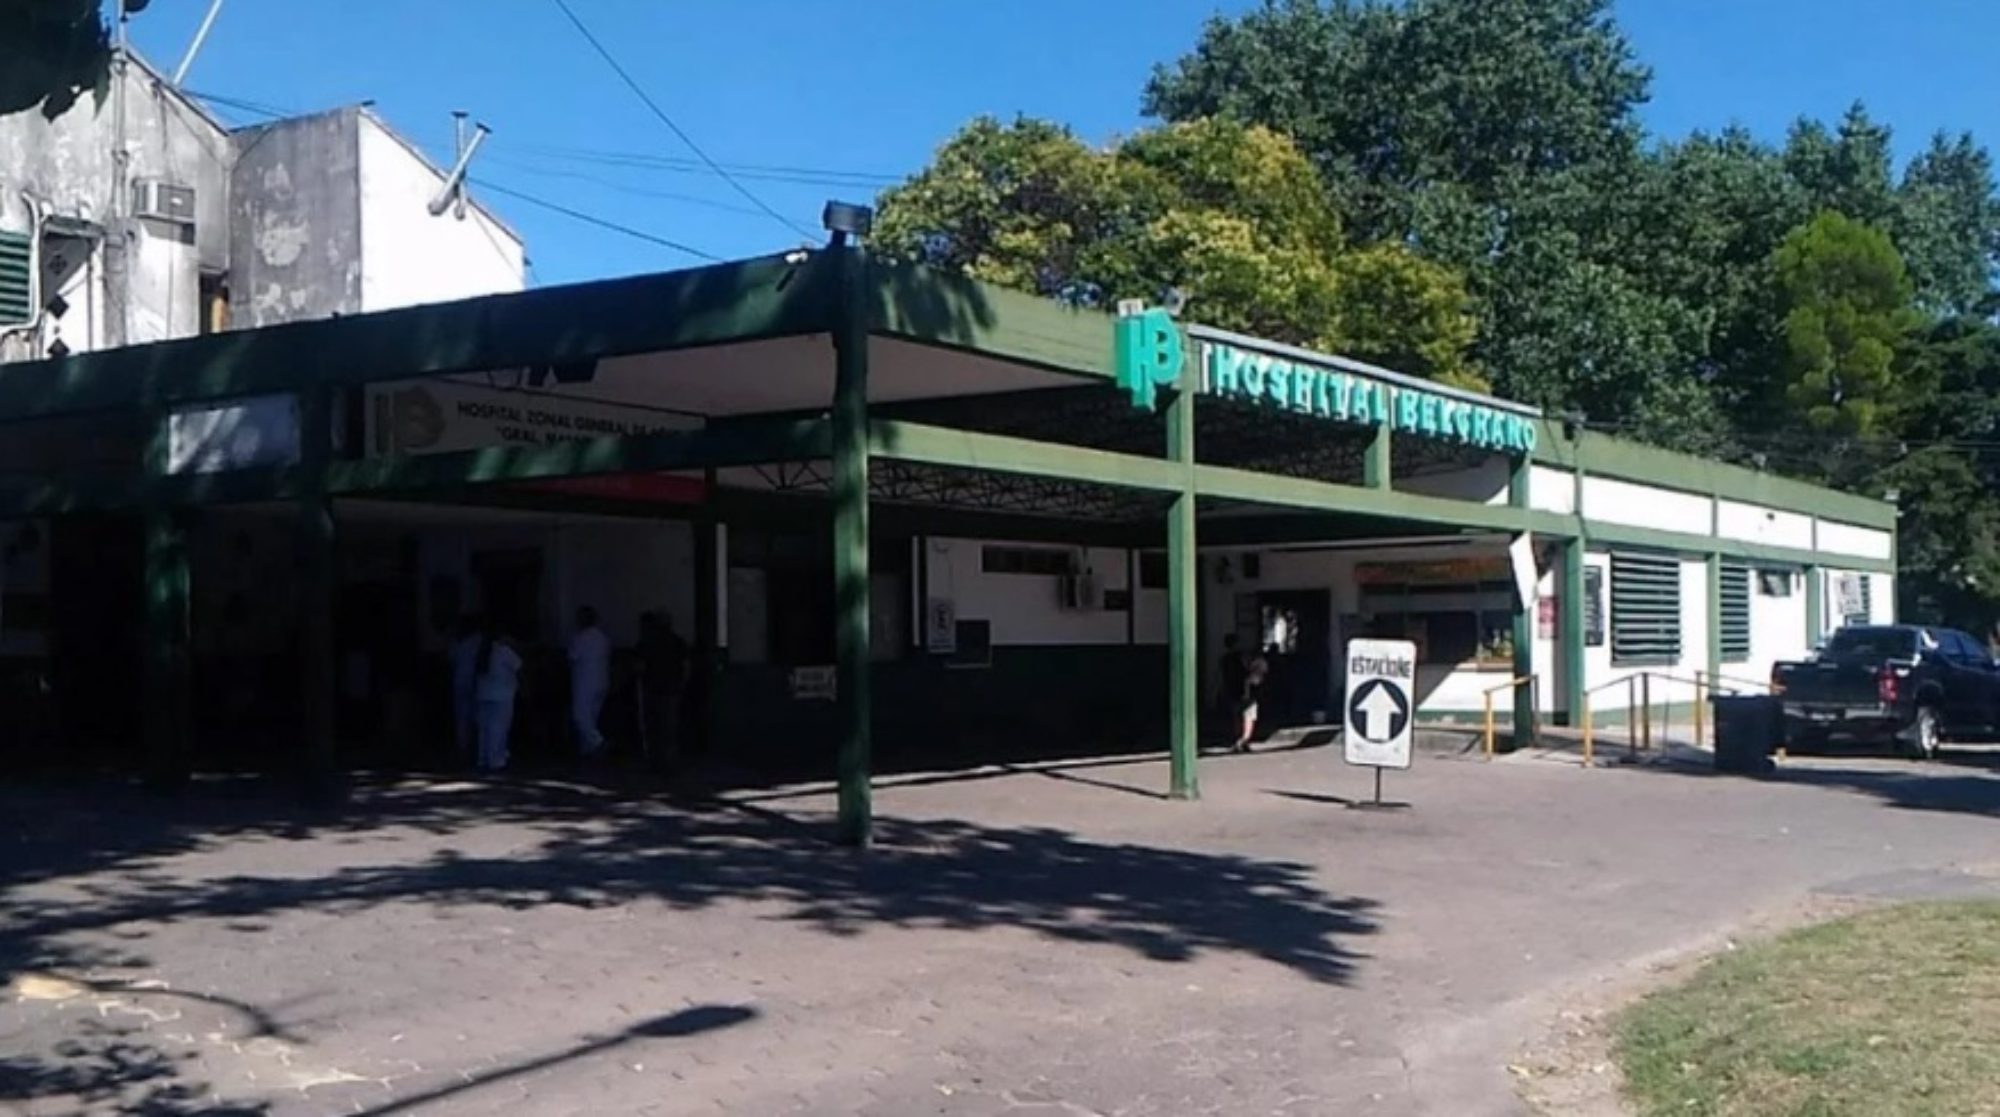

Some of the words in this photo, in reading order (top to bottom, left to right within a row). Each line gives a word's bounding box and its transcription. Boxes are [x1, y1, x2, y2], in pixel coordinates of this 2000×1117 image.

[458, 401, 523, 422] HOSPITAL
[526, 409, 572, 429] ZONAL
[574, 415, 628, 436] GENERAL
[1208, 342, 1390, 425] HOSPITAL
[1399, 388, 1537, 451] BELGRANO
